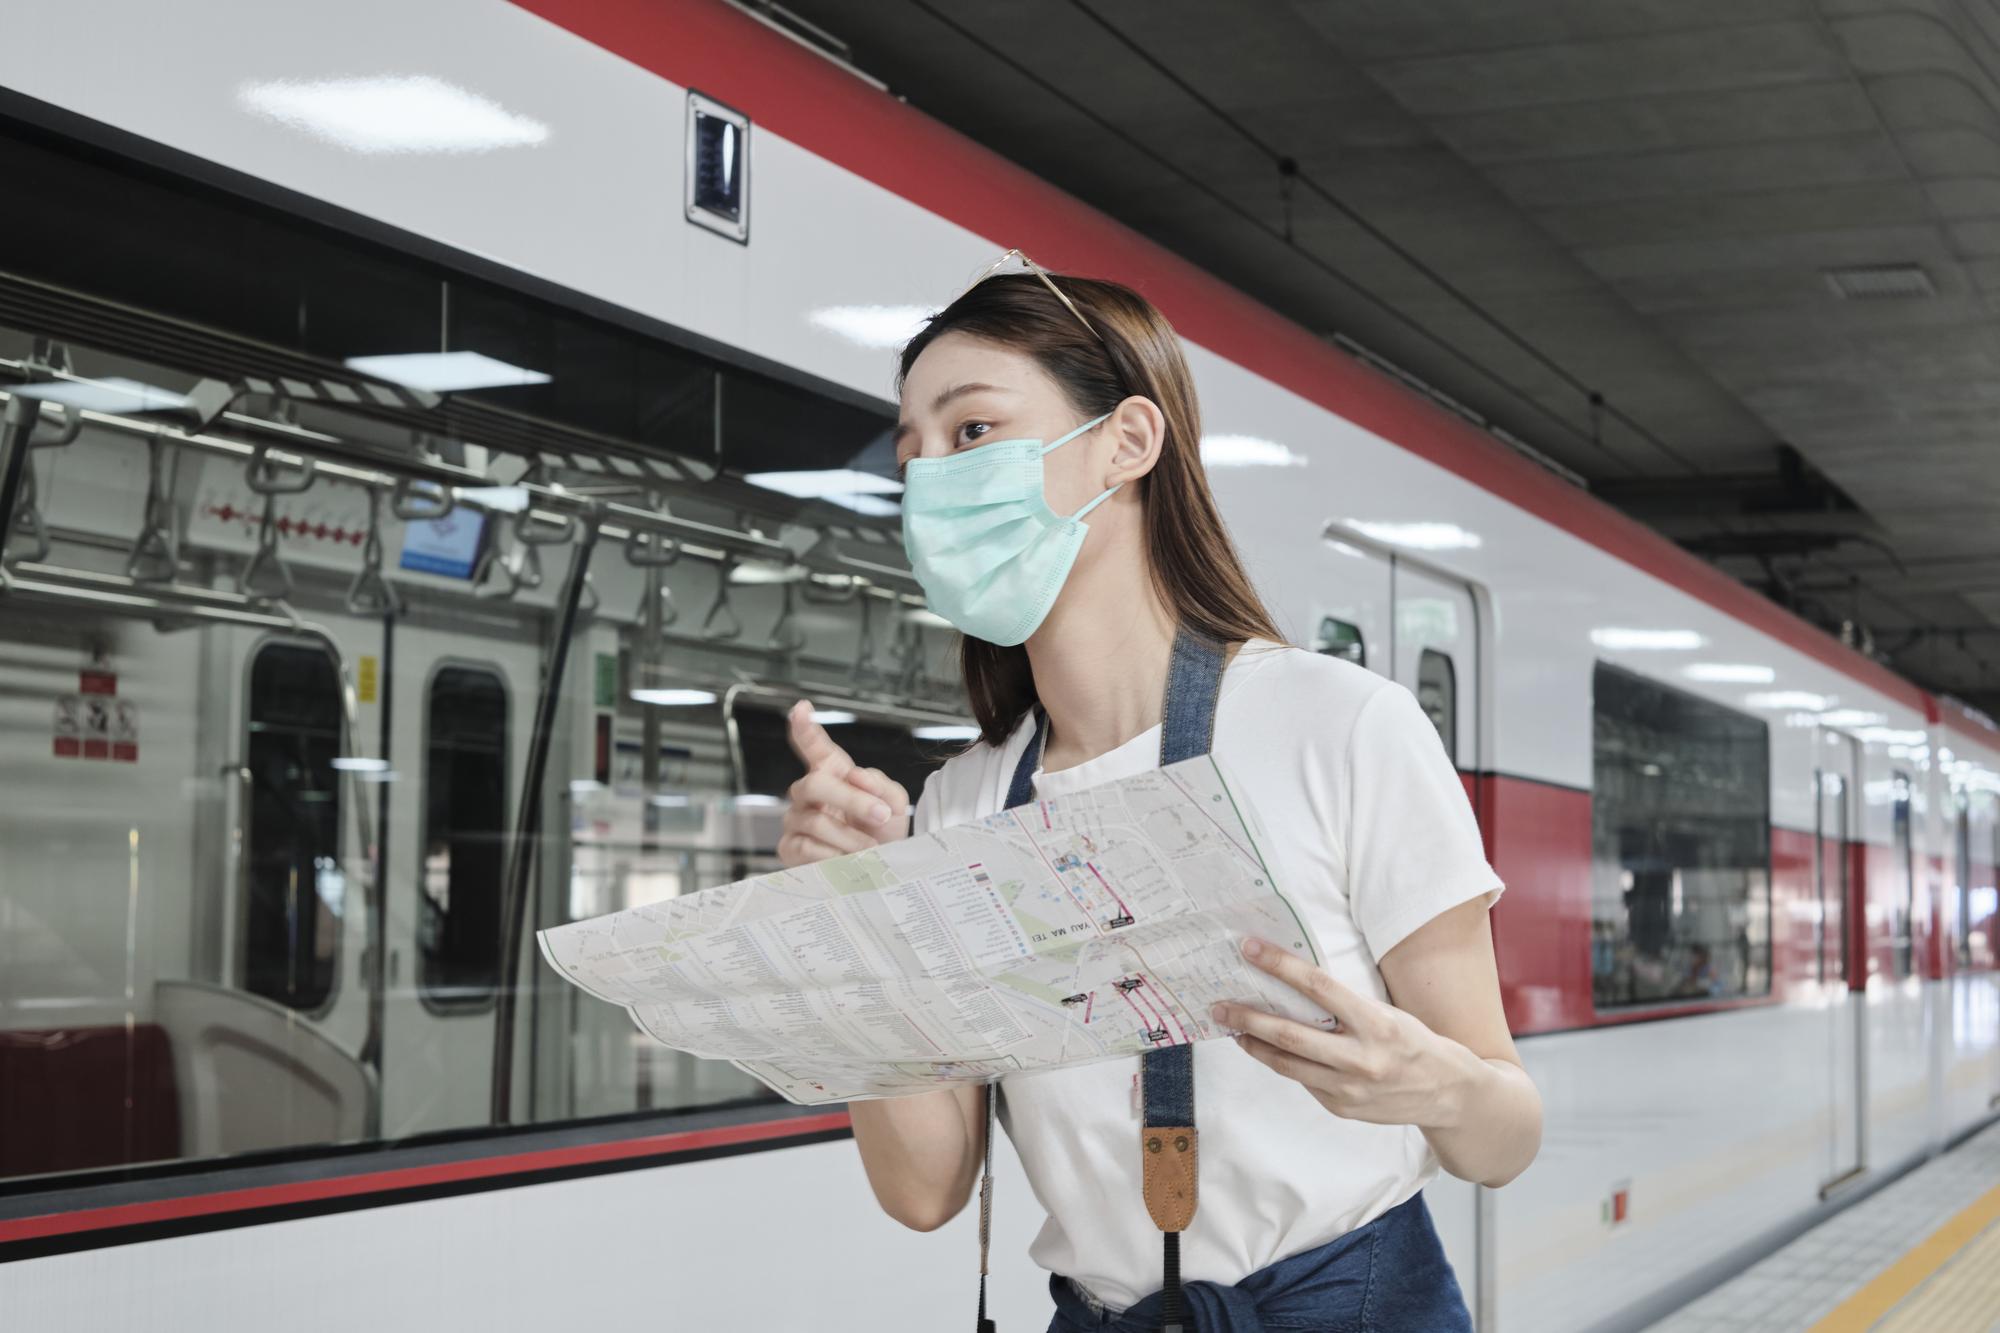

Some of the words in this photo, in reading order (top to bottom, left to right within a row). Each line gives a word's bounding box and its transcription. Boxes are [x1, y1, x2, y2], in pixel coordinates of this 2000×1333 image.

[1071, 922, 1090, 932] YAU
[1051, 928, 1067, 936] MA
[1032, 933, 1047, 942] TEI
